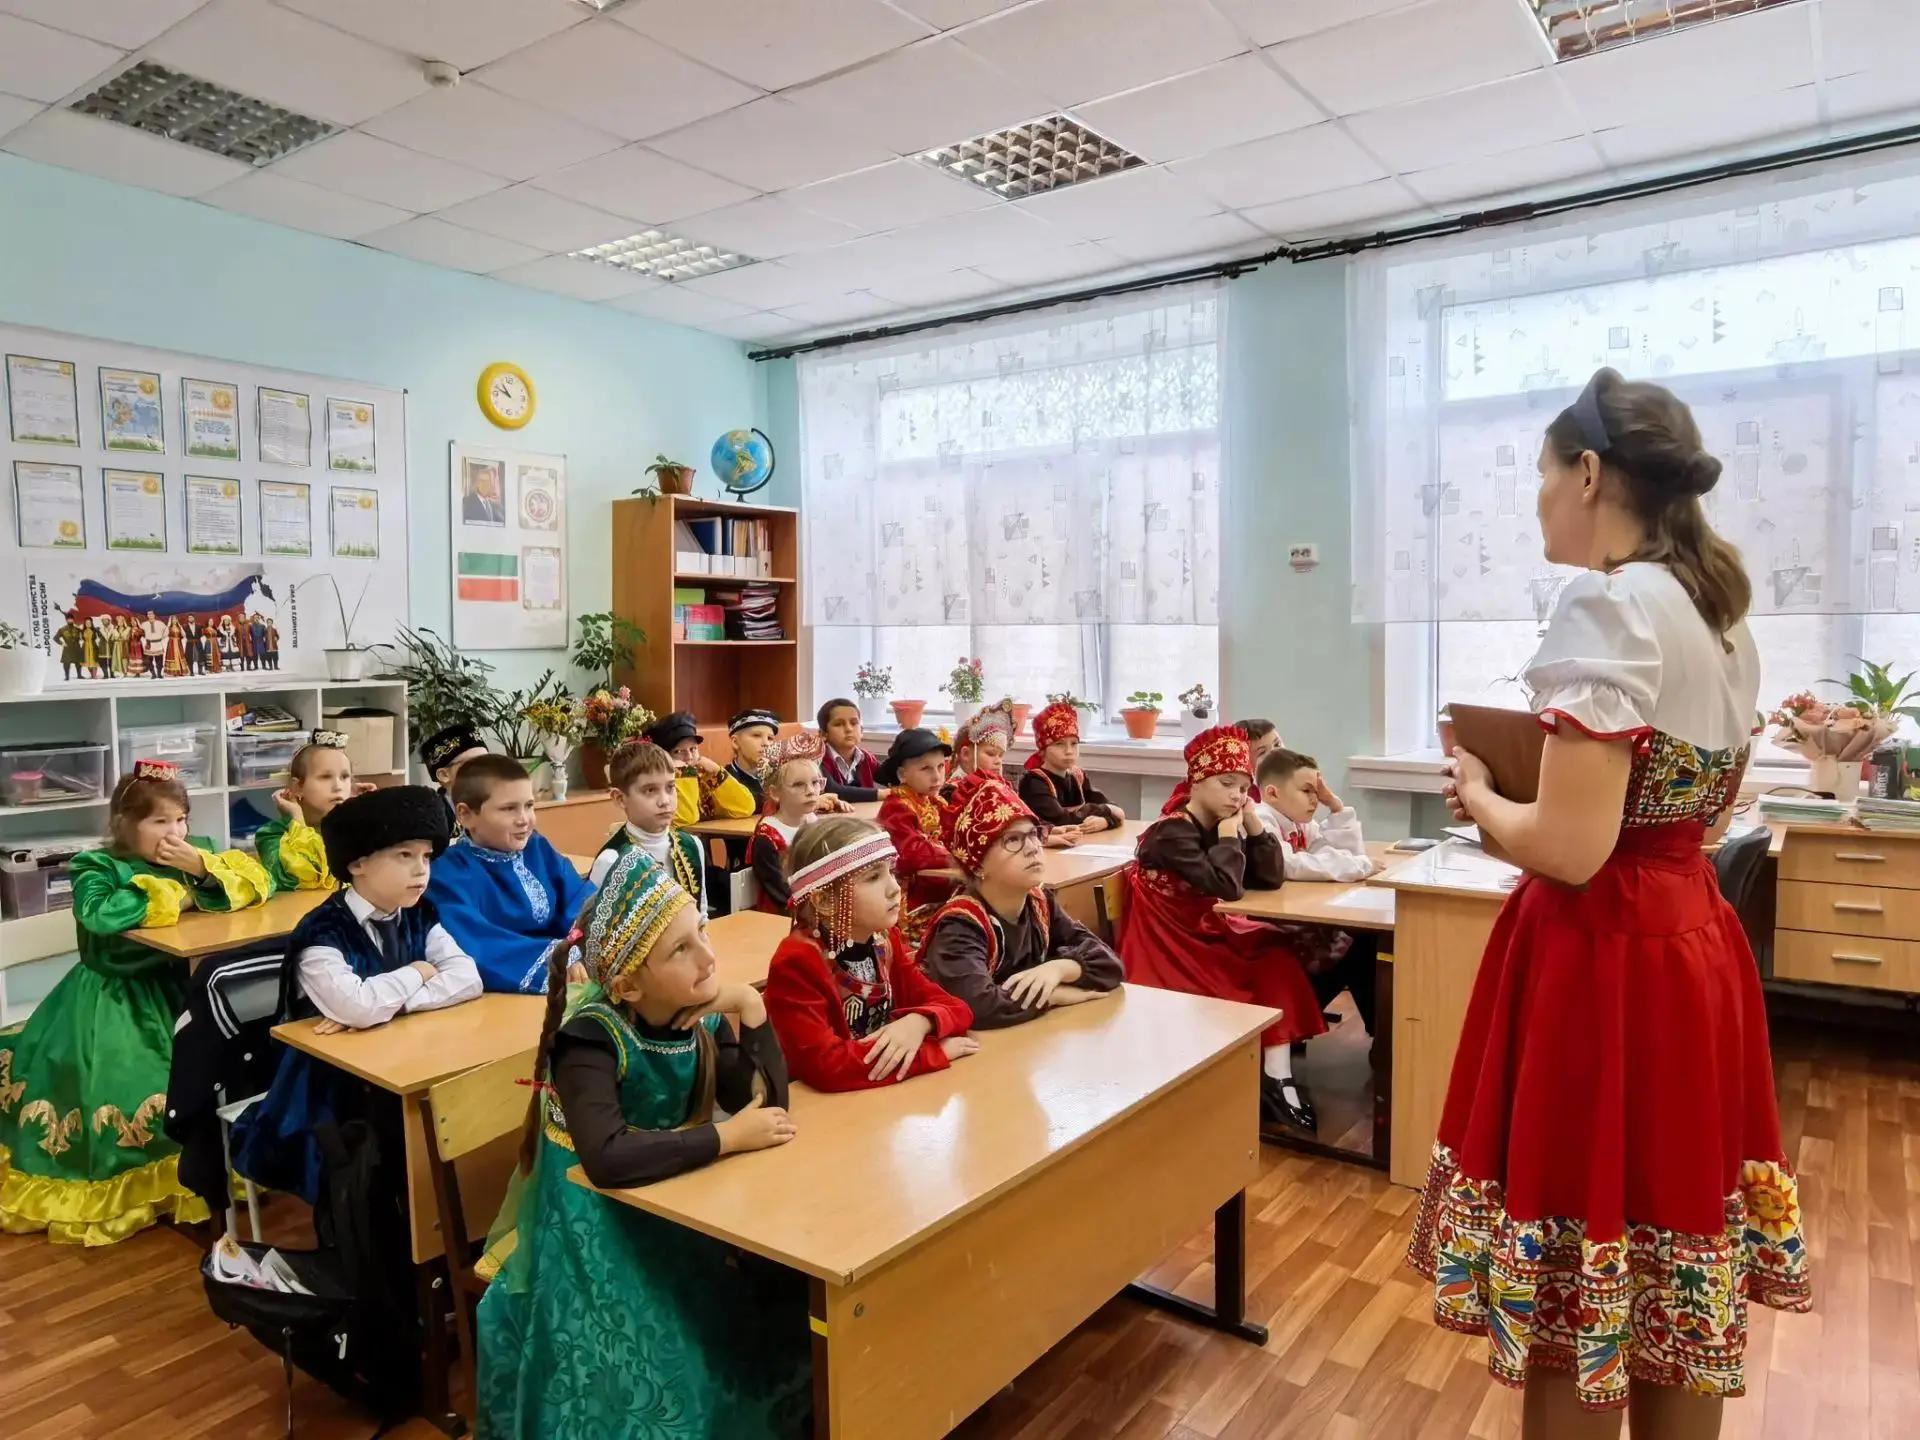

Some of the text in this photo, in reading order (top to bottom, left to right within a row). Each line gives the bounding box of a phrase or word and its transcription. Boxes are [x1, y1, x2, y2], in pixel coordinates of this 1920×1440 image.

[29, 575, 39, 618] ЕДИНСТВА
[39, 582, 48, 616] РОССИИ
[32, 620, 40, 637] ГОД
